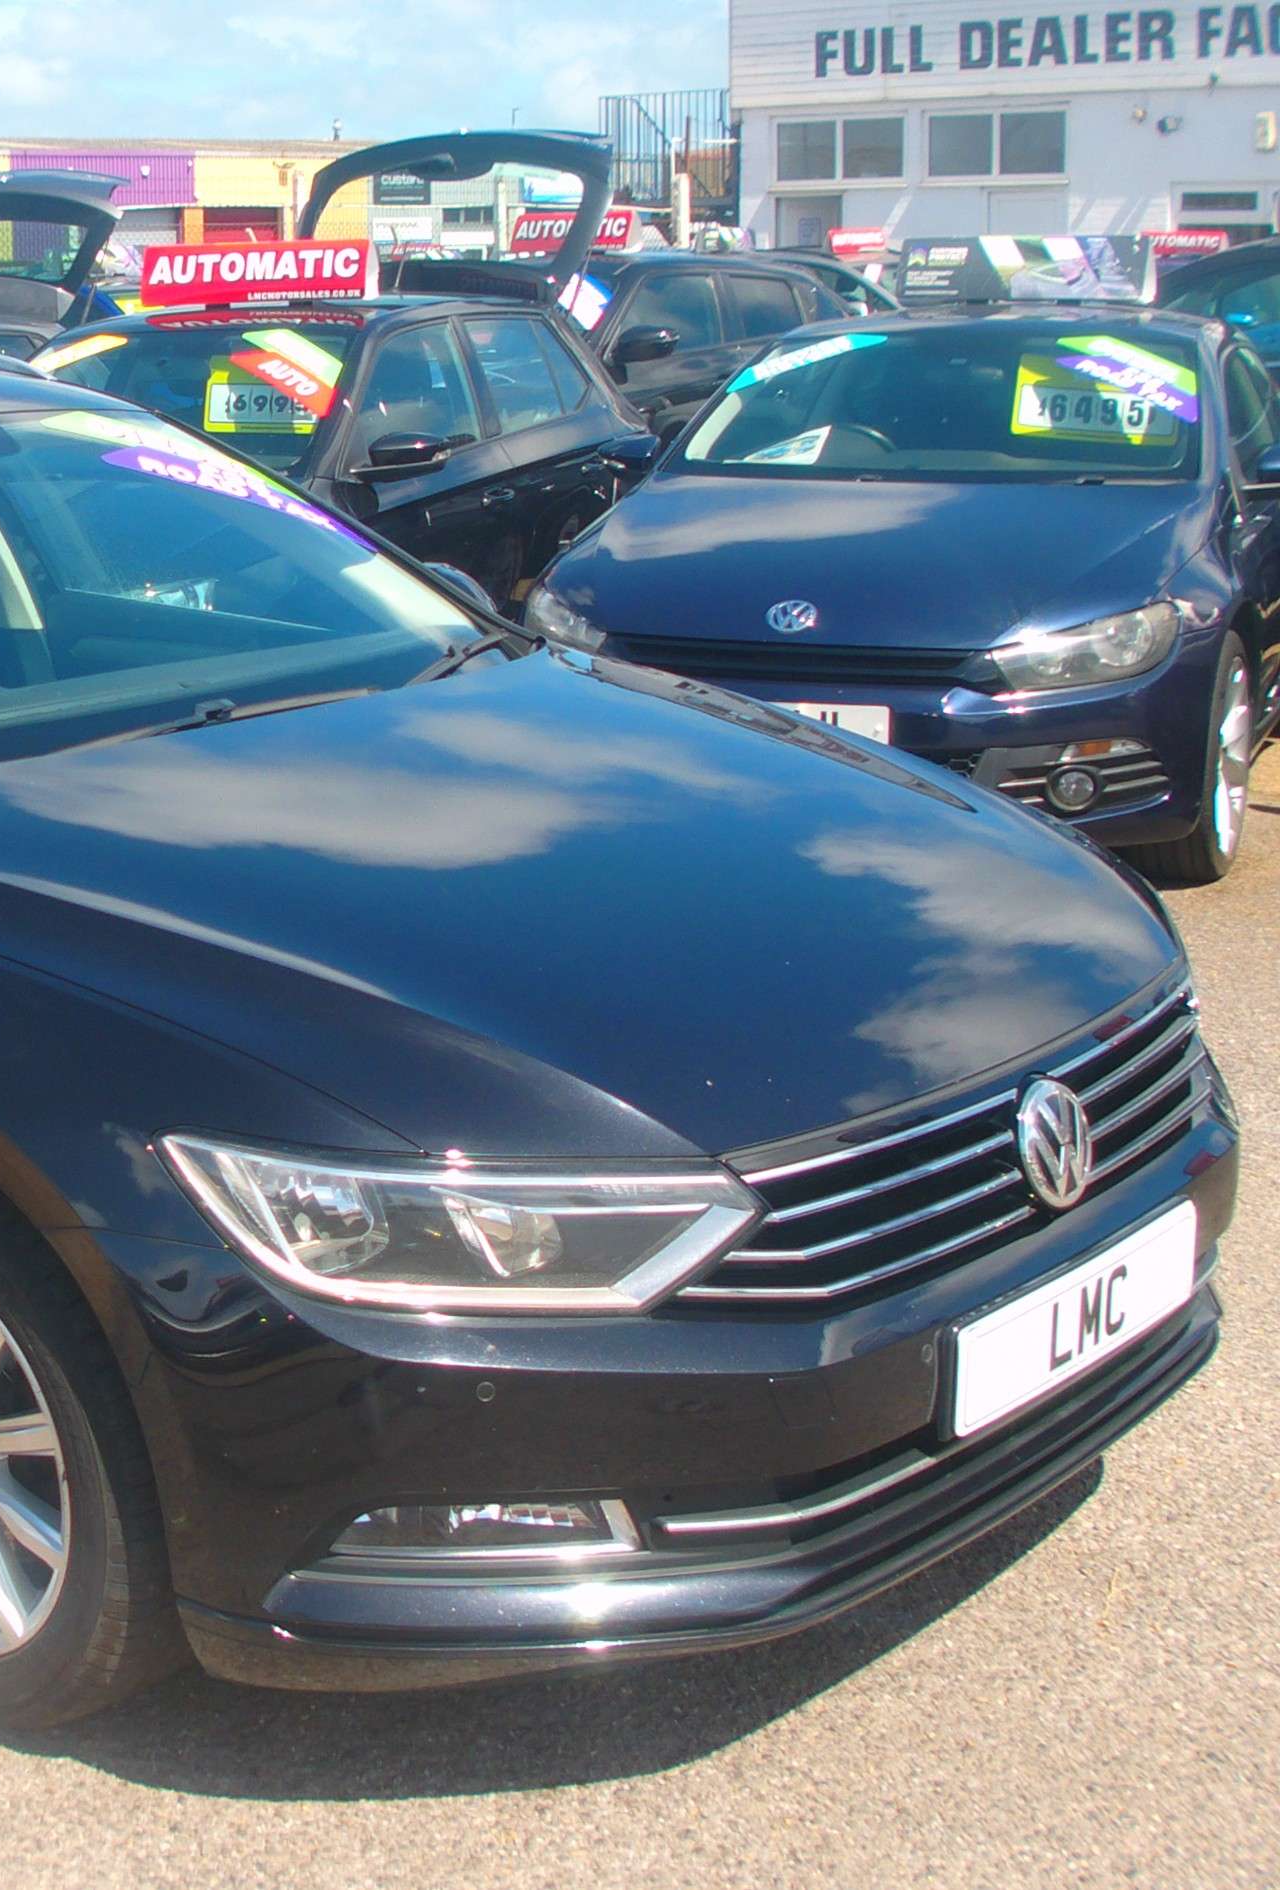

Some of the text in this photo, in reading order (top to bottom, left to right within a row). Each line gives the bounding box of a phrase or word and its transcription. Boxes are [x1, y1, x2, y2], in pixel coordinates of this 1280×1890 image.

[814, 25, 933, 78] FULL
[959, 9, 1176, 70] DEALER
[149, 247, 360, 285] AUTOMATIC
[257, 359, 319, 396] AUTO
[1049, 1263, 1128, 1372] LMC
